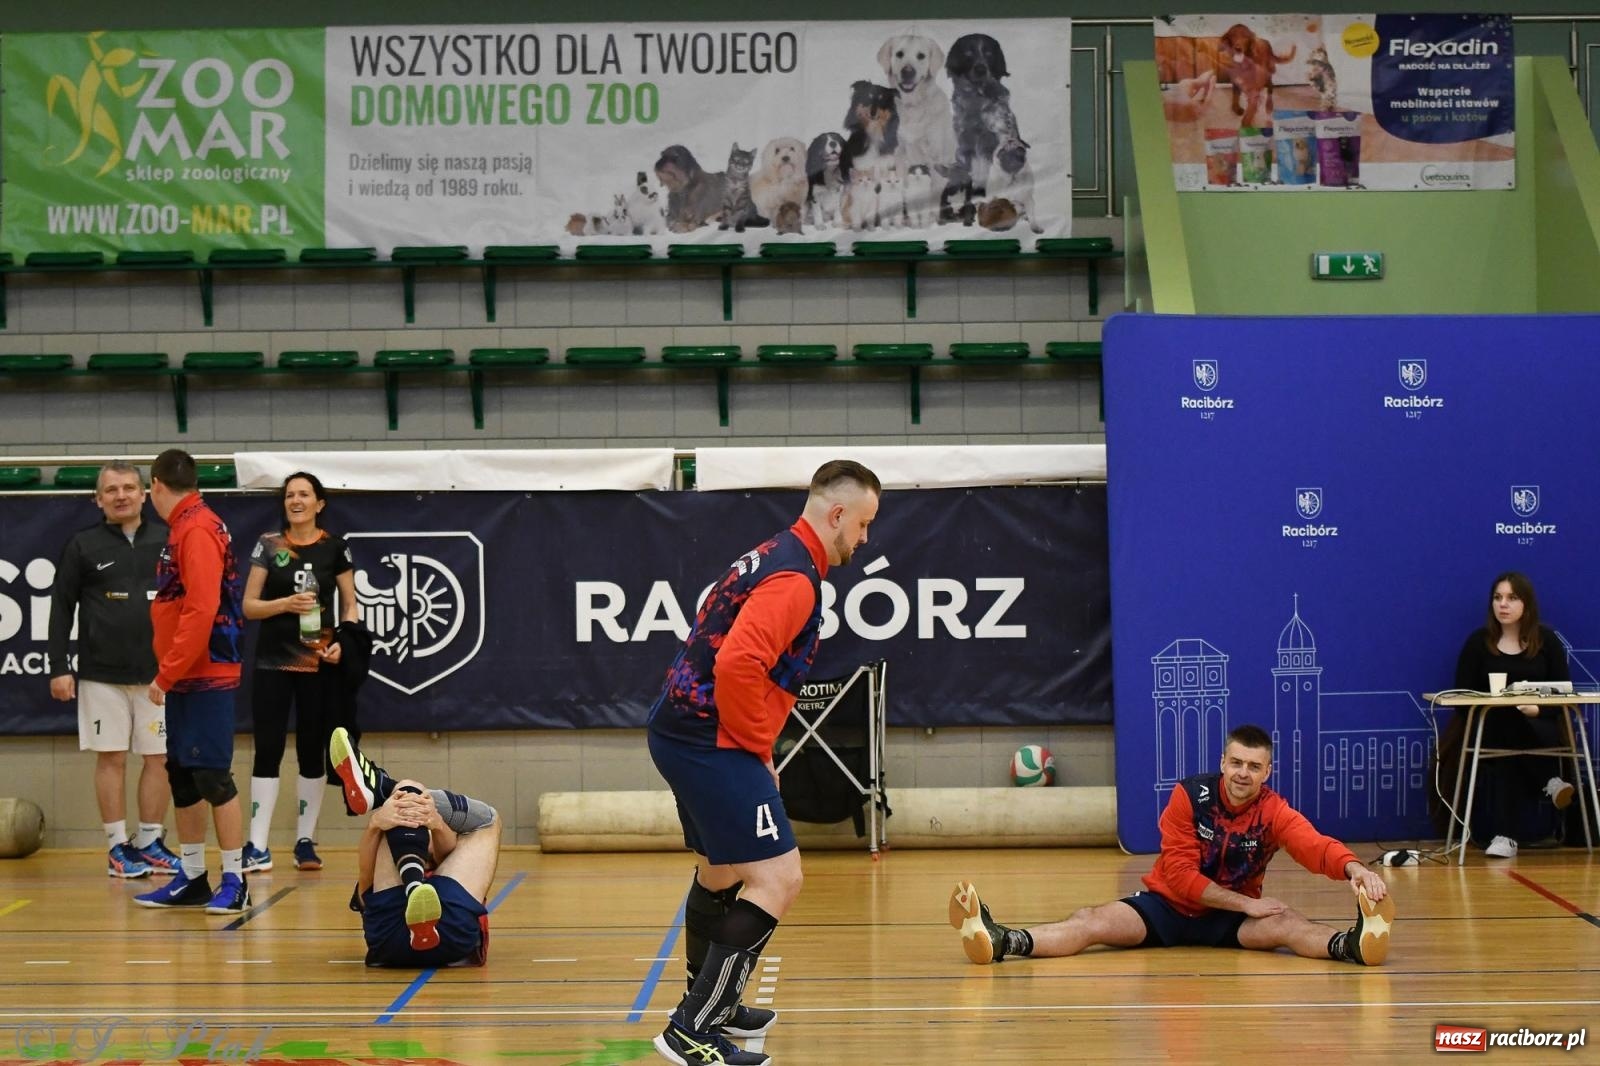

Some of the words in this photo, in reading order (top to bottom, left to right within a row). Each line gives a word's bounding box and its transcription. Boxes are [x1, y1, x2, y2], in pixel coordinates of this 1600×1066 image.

[350, 34, 541, 77] WSZYSTKO
[556, 33, 622, 76] DLA
[634, 31, 798, 75] TWOJEGO
[1389, 38, 1499, 58] Flexadin
[135, 58, 294, 108] ZOO
[1418, 86, 1472, 98] Wsparcie
[351, 83, 570, 126] DOMOWEGO
[586, 82, 660, 125] ZOO
[1390, 98, 1453, 109] mobilności
[125, 110, 291, 161] MAR
[126, 164, 174, 182] sklep
[181, 164, 291, 184] zoologiczny
[349, 153, 412, 174] Dzielimy
[417, 153, 438, 175] się
[444, 156, 487, 175] naszą
[492, 153, 532, 175] pasją
[358, 179, 409, 200] wiedzą
[415, 179, 434, 196] od
[440, 178, 478, 196] 1989
[483, 178, 523, 196] roku.
[47, 203, 294, 236] WWW.ZOO-MAR.PL
[1181, 396, 1234, 409] Racibórz
[1384, 395, 1444, 408] Racibórz
[1282, 524, 1338, 537] Racibórz
[1495, 522, 1557, 534] Racibórz
[294, 570, 307, 593] 9
[575, 555, 1028, 643] RAÓRZ
[94, 719, 101, 735] 1
[756, 803, 779, 841] 4
